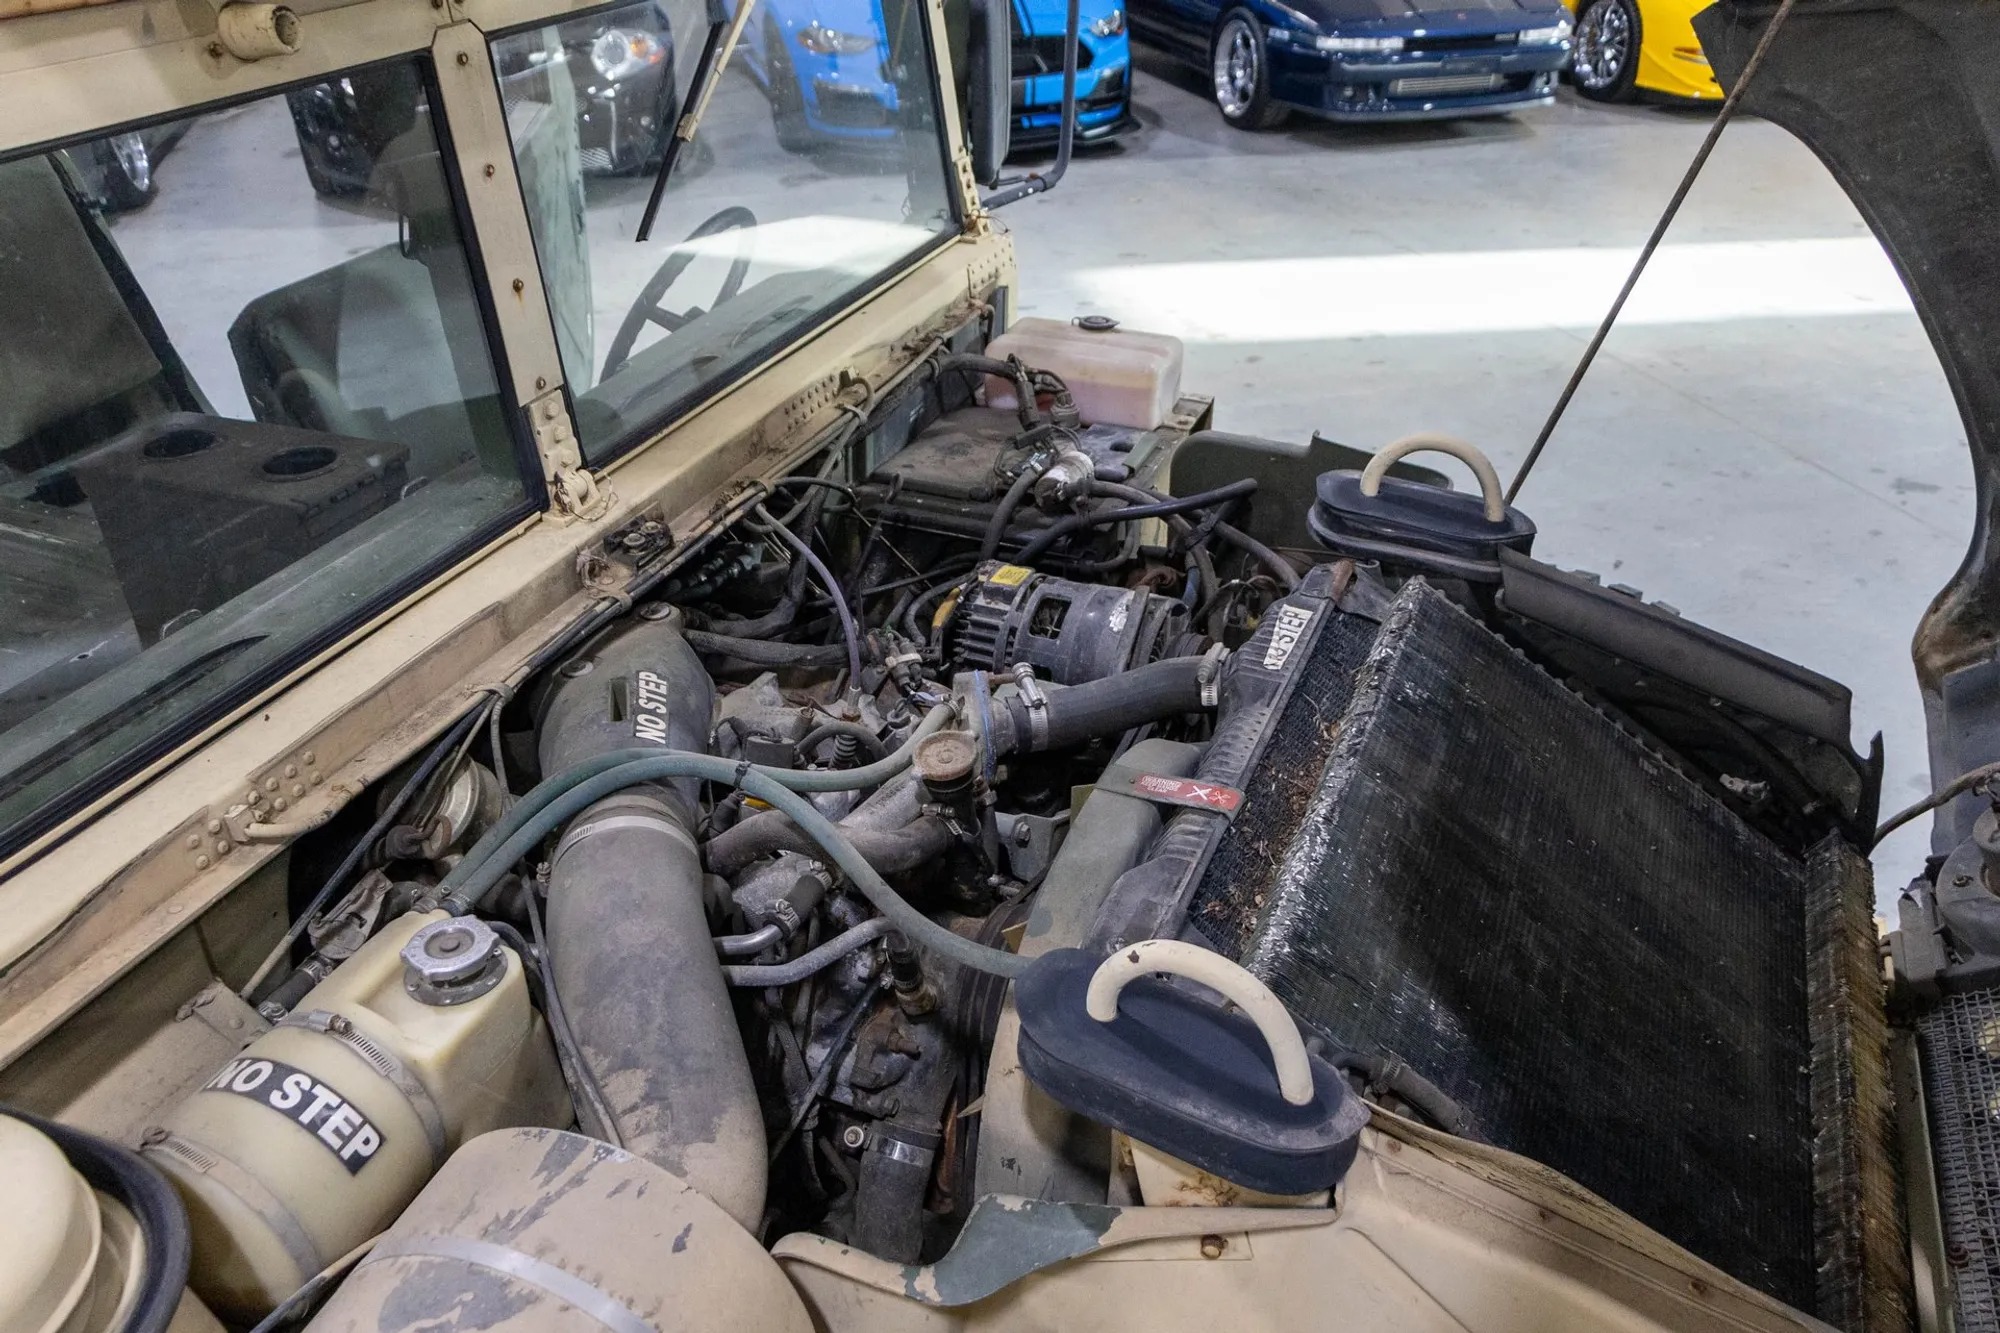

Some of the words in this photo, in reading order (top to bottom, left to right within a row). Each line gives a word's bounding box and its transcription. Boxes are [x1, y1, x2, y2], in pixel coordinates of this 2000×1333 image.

[1278, 610, 1307, 643] STEP
[638, 671, 668, 713] STEP
[635, 713, 667, 744] NO
[207, 1059, 274, 1092] NO
[269, 1073, 381, 1160] STEP
